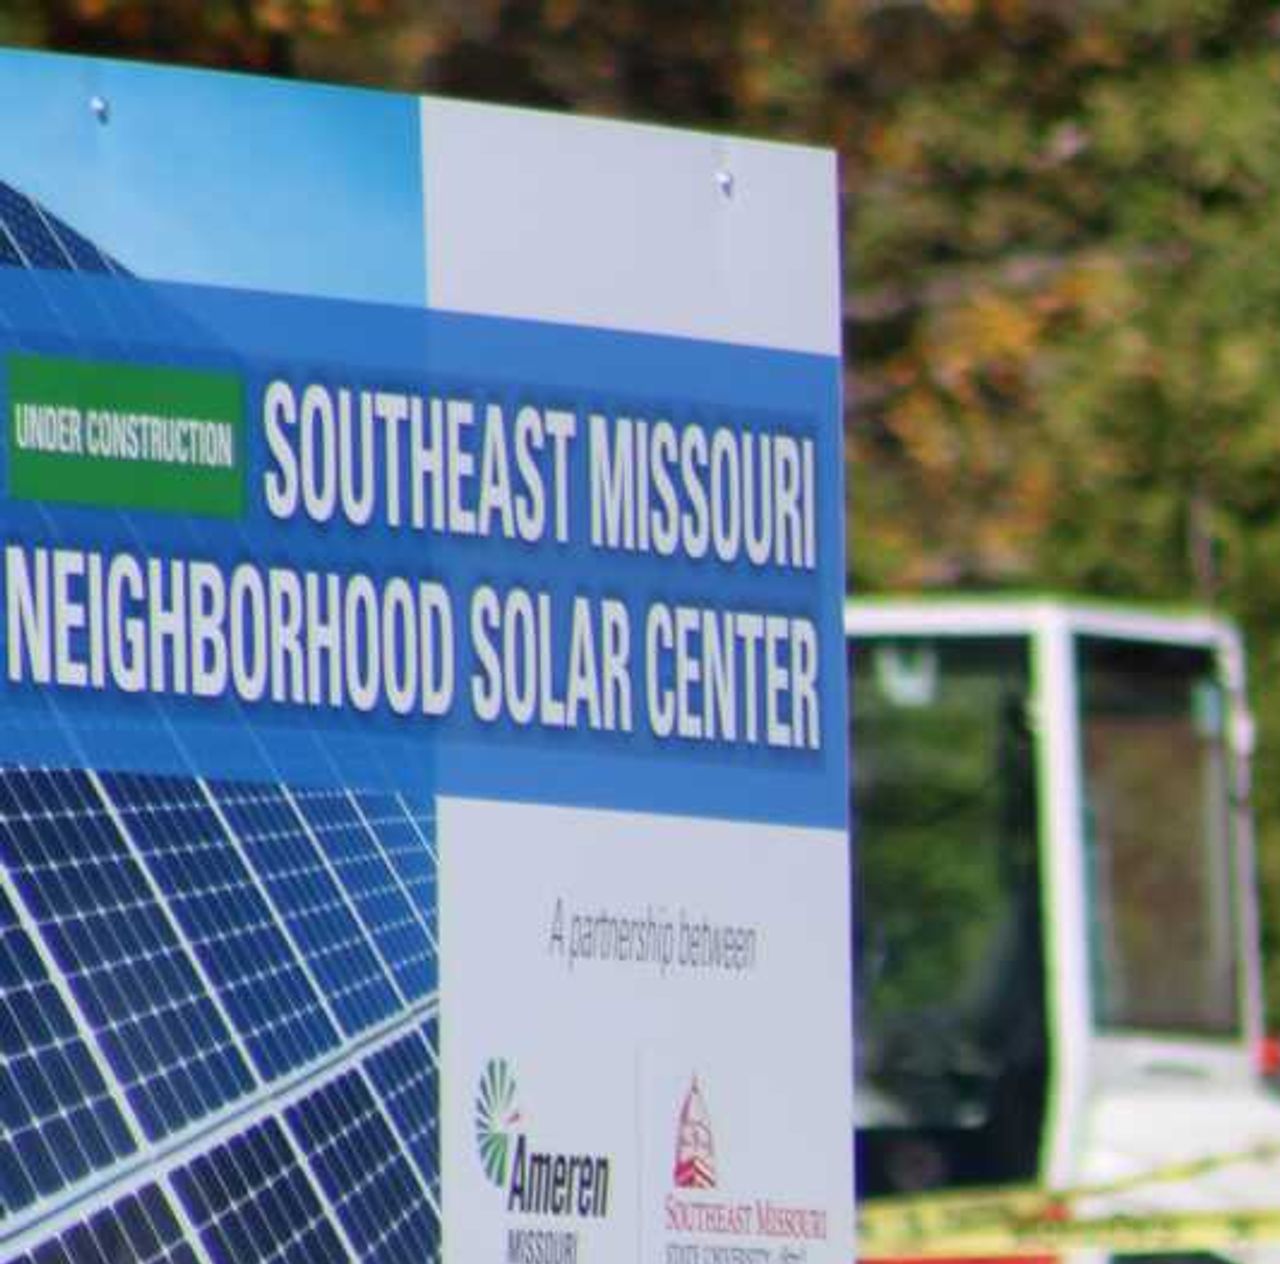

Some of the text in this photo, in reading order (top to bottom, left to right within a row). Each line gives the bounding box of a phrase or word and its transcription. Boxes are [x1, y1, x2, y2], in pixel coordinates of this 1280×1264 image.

[14, 403, 234, 468] UNDER CONSTRUCTION
[264, 379, 816, 571] SOUTHEAST MISSOURI
[5, 545, 822, 750] NEIGHBORHOOD SOLAR CENTER
[549, 897, 758, 980] A partnership between
[508, 1134, 609, 1219] Ameren
